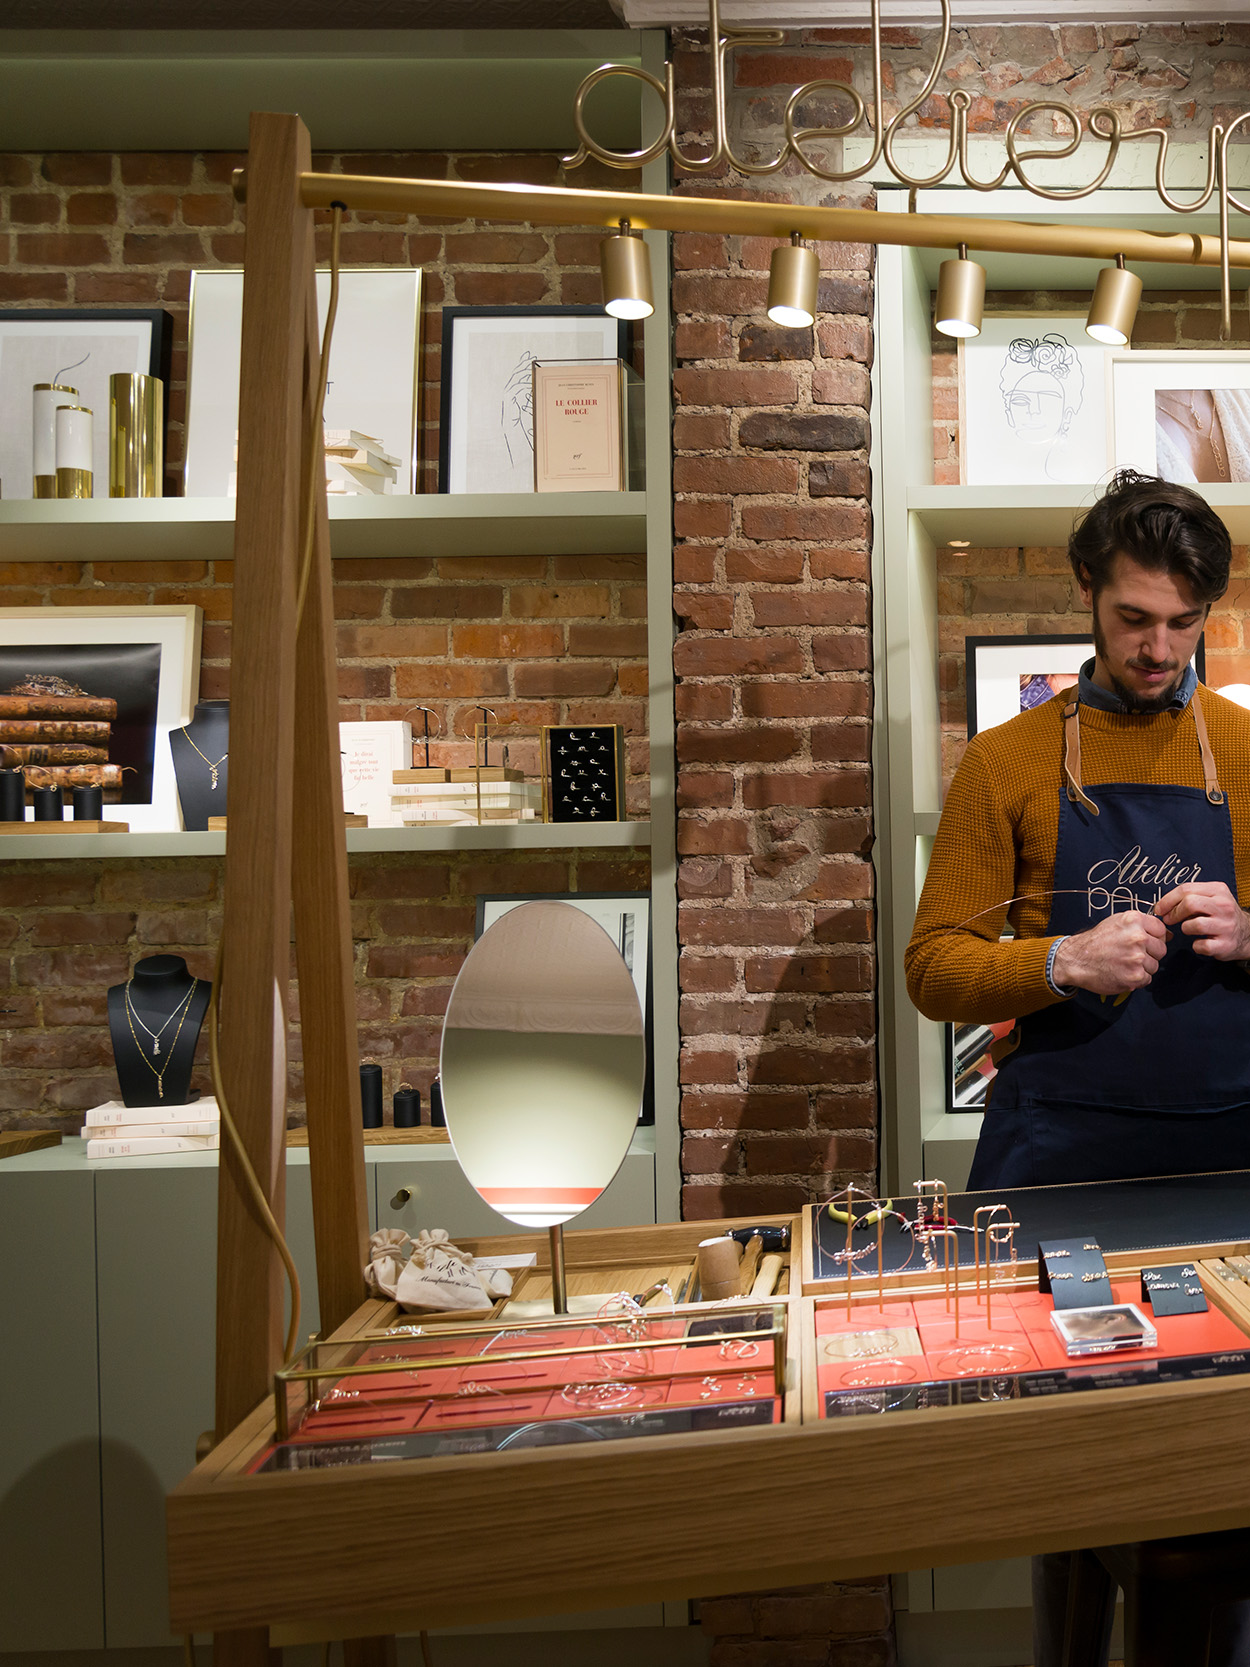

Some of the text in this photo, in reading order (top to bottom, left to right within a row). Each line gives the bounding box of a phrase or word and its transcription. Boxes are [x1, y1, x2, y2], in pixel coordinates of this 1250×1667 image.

[555, 398, 598, 407] LE COLLIER
[564, 408, 589, 416] ROUGE
[1087, 844, 1202, 886] Atelier
